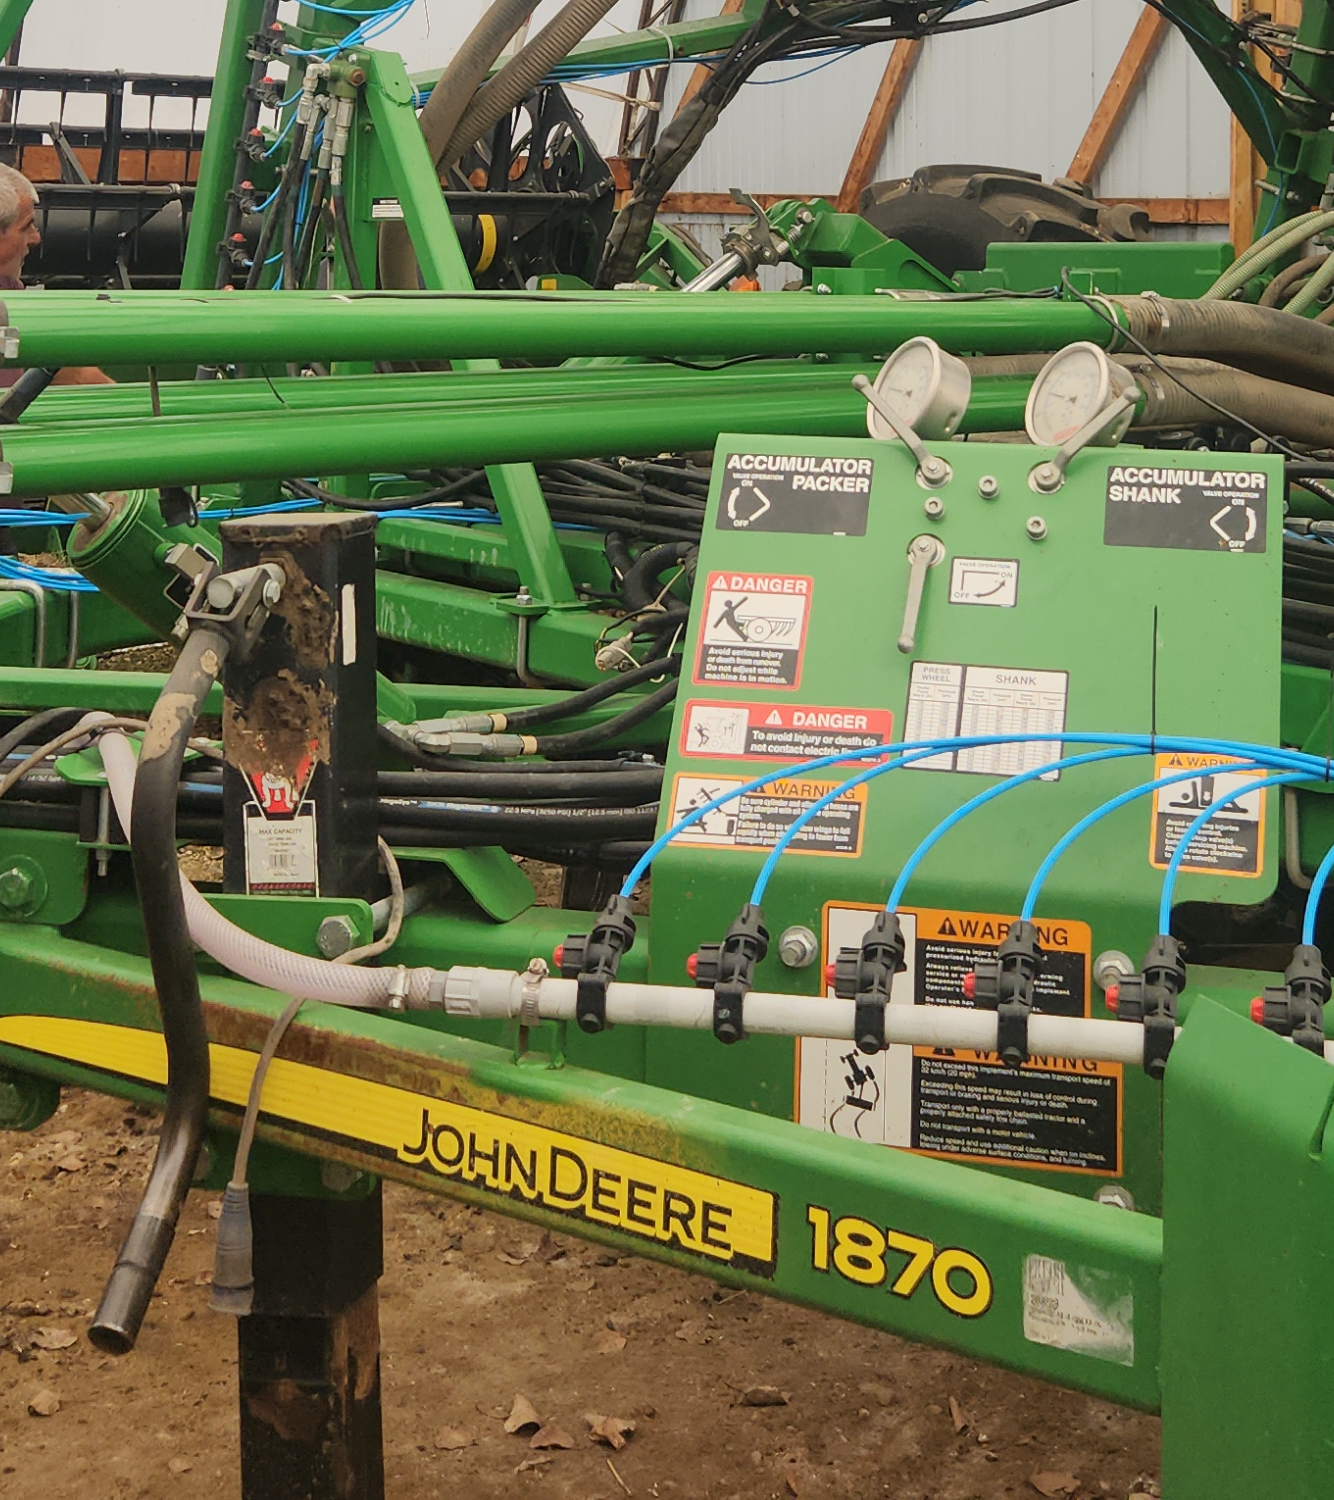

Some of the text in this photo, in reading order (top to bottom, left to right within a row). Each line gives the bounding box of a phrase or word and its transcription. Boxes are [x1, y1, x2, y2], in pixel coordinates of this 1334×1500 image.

[727, 454, 872, 475] ACCUMULATOR
[741, 480, 753, 488] ON
[792, 475, 870, 493] PACKER
[1110, 468, 1266, 489] ACCUMULATOR
[1109, 486, 1182, 504] SHANK
[733, 520, 749, 528] OFF
[1228, 540, 1246, 548] OFF
[731, 576, 807, 593] DANGER
[922, 674, 950, 682] WHEEL
[923, 666, 951, 675] PRESS
[996, 674, 1037, 686] SHANK
[793, 712, 867, 729] DANGER
[752, 730, 876, 746] To avoid injury or death do
[959, 919, 1068, 945] WARNG
[400, 1108, 735, 1258] JOHN DEERE
[807, 1204, 993, 1318] 1870
